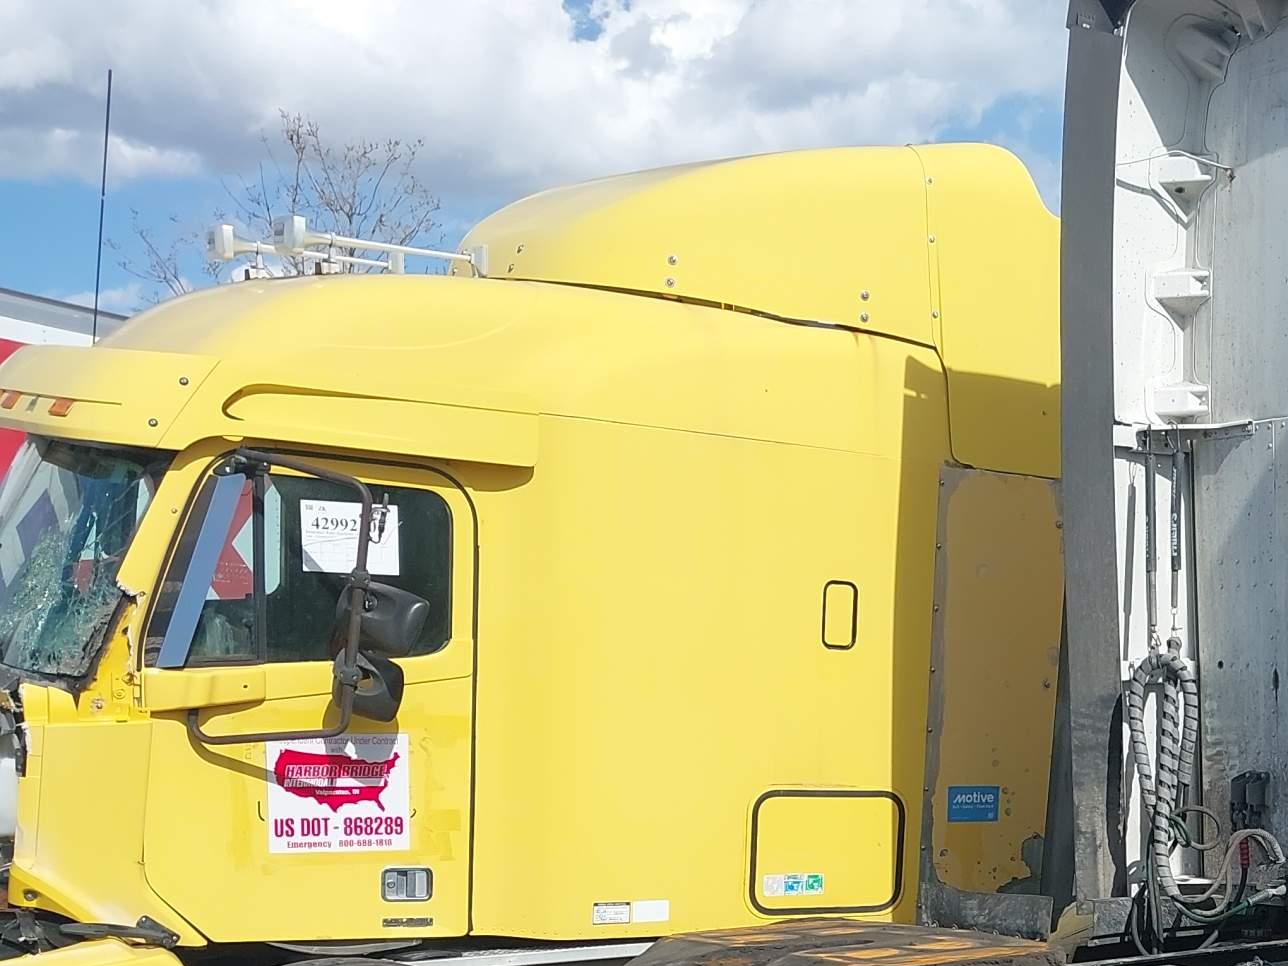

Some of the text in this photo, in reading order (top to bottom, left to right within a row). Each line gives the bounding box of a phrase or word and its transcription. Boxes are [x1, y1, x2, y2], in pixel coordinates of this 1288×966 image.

[285, 764, 388, 778] HARBOR BRIDGE
[952, 791, 995, 804] Motive
[273, 817, 295, 838] US
[300, 817, 330, 837] DOT
[343, 816, 404, 836] 868289
[287, 840, 332, 849] Emergency
